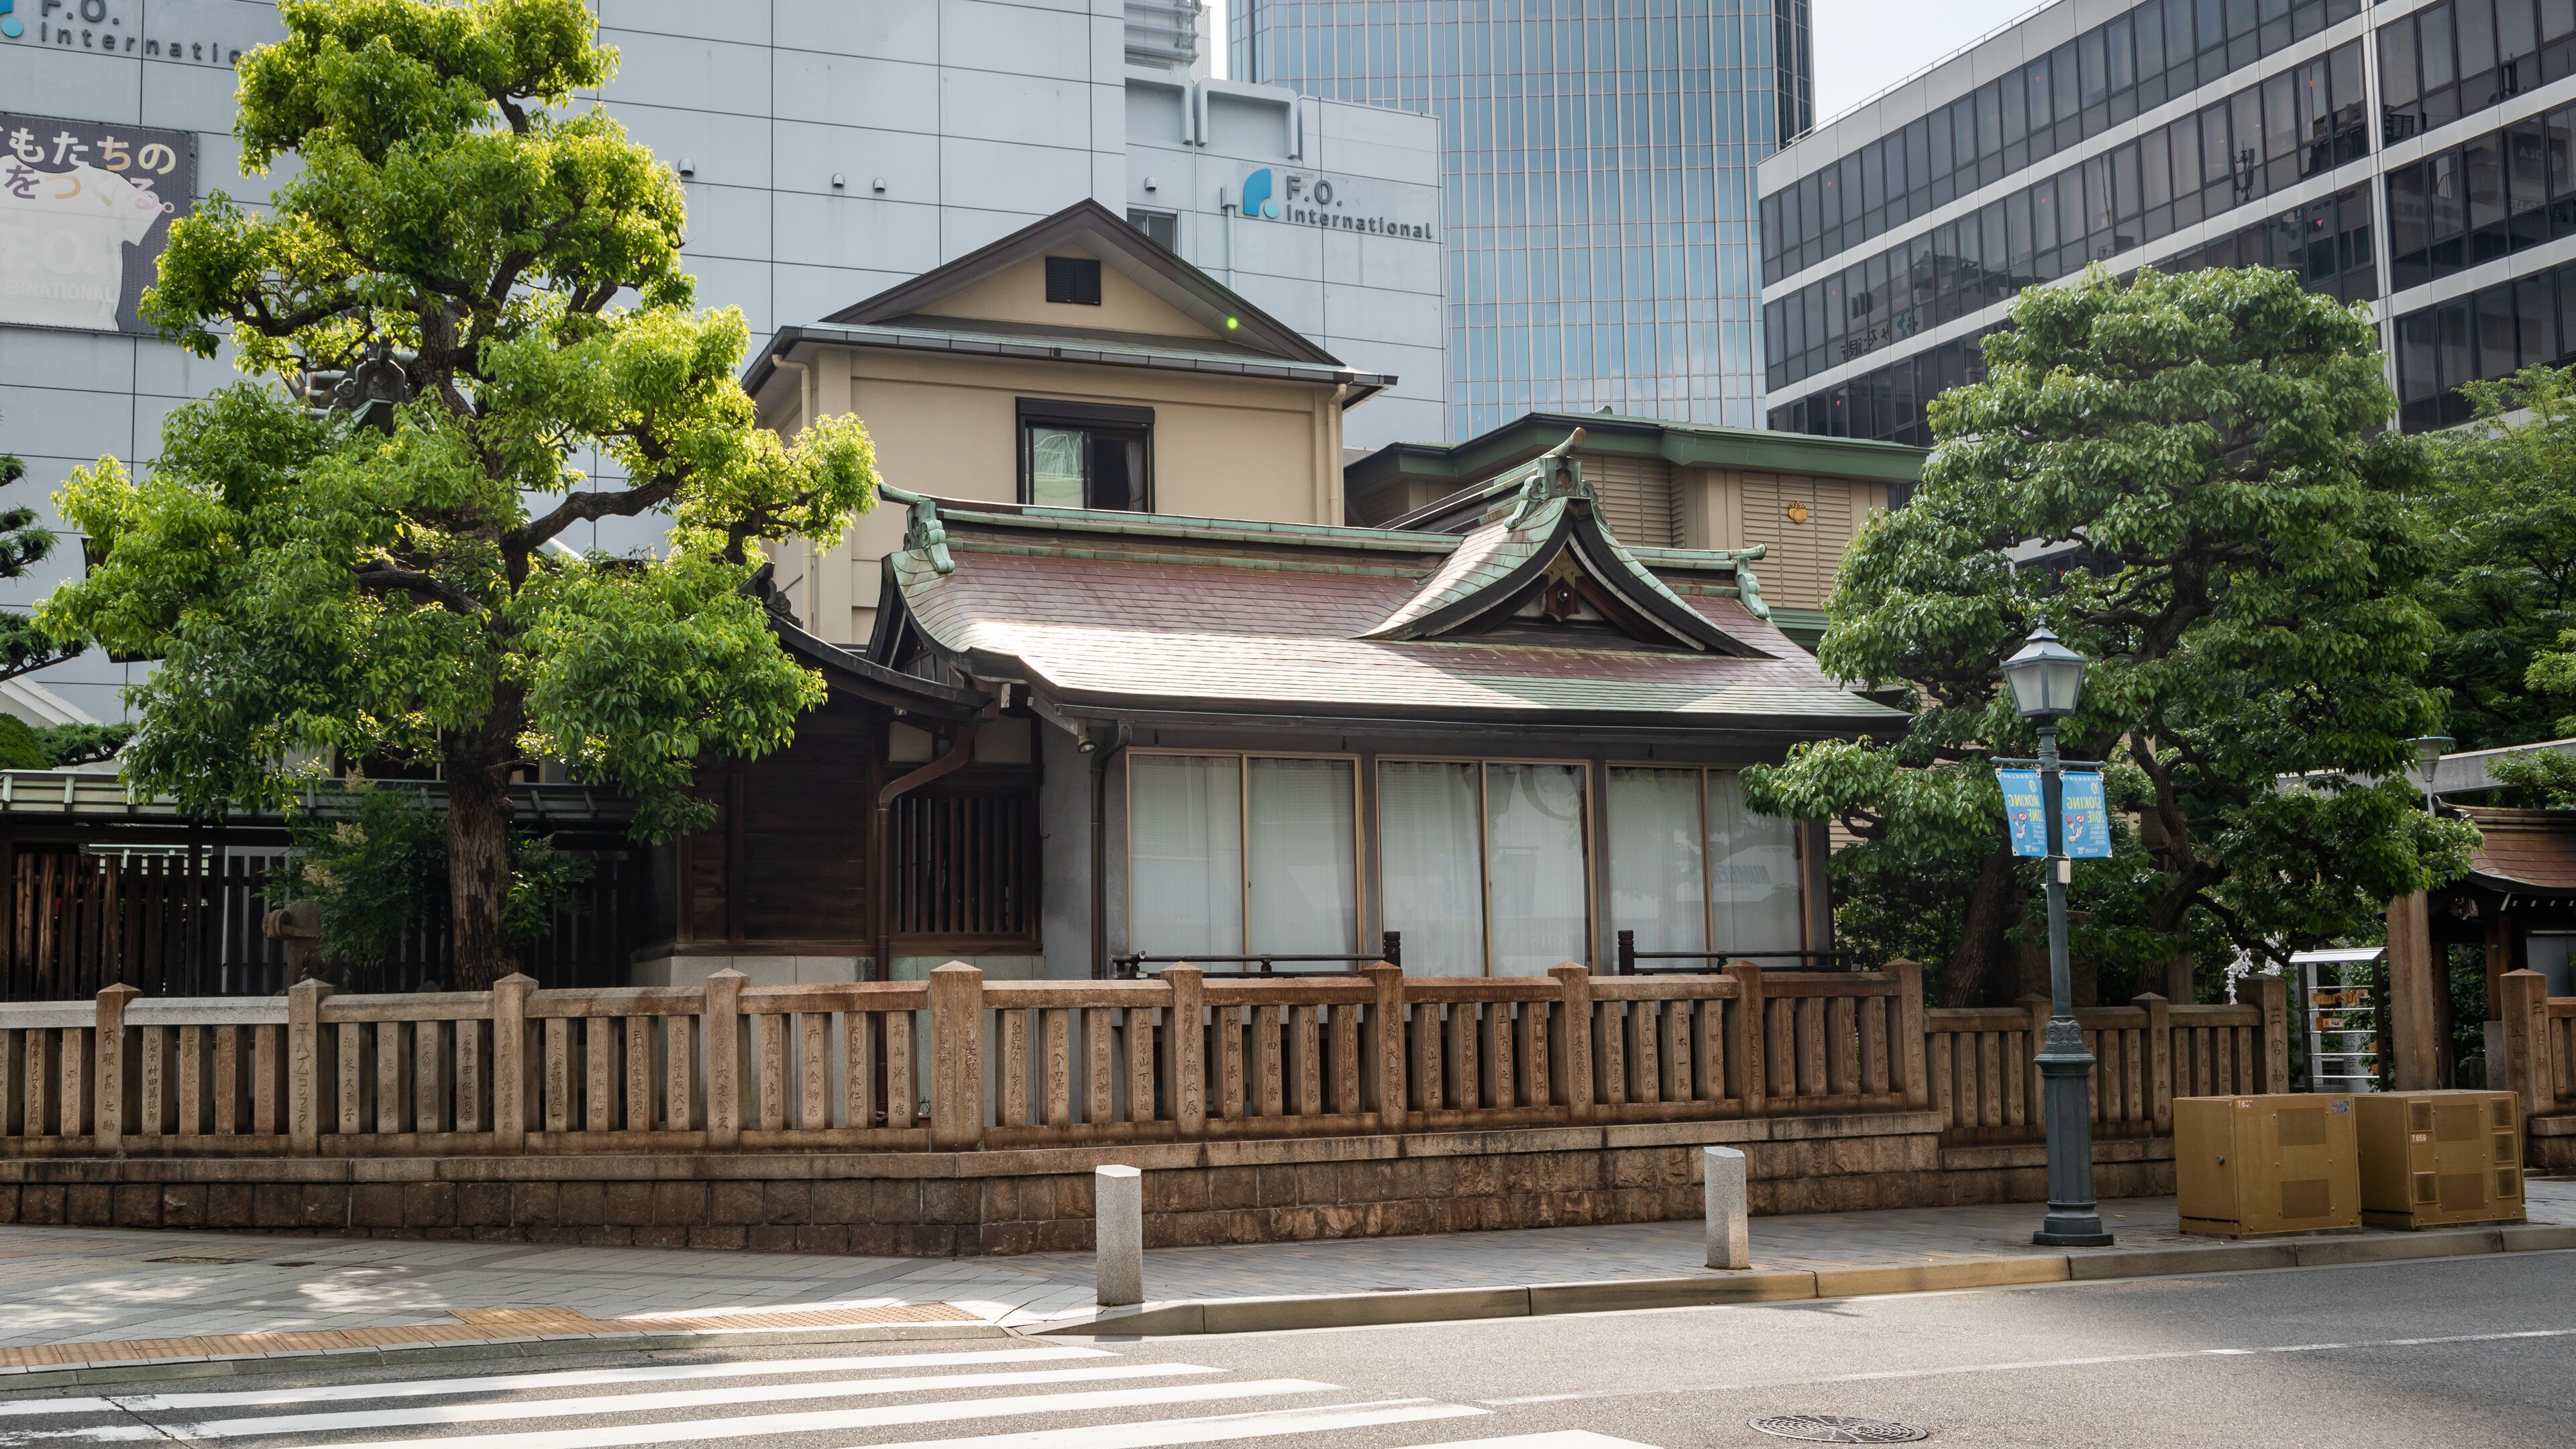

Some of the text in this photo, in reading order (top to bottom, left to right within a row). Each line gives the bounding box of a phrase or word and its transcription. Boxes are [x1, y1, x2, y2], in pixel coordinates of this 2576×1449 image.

[42, 22, 240, 64] Internatio
[0, 124, 176, 174] もたちの
[1287, 175, 1342, 207] F.O.
[1287, 204, 1432, 239] International
[2411, 1134, 2426, 1142] T659
